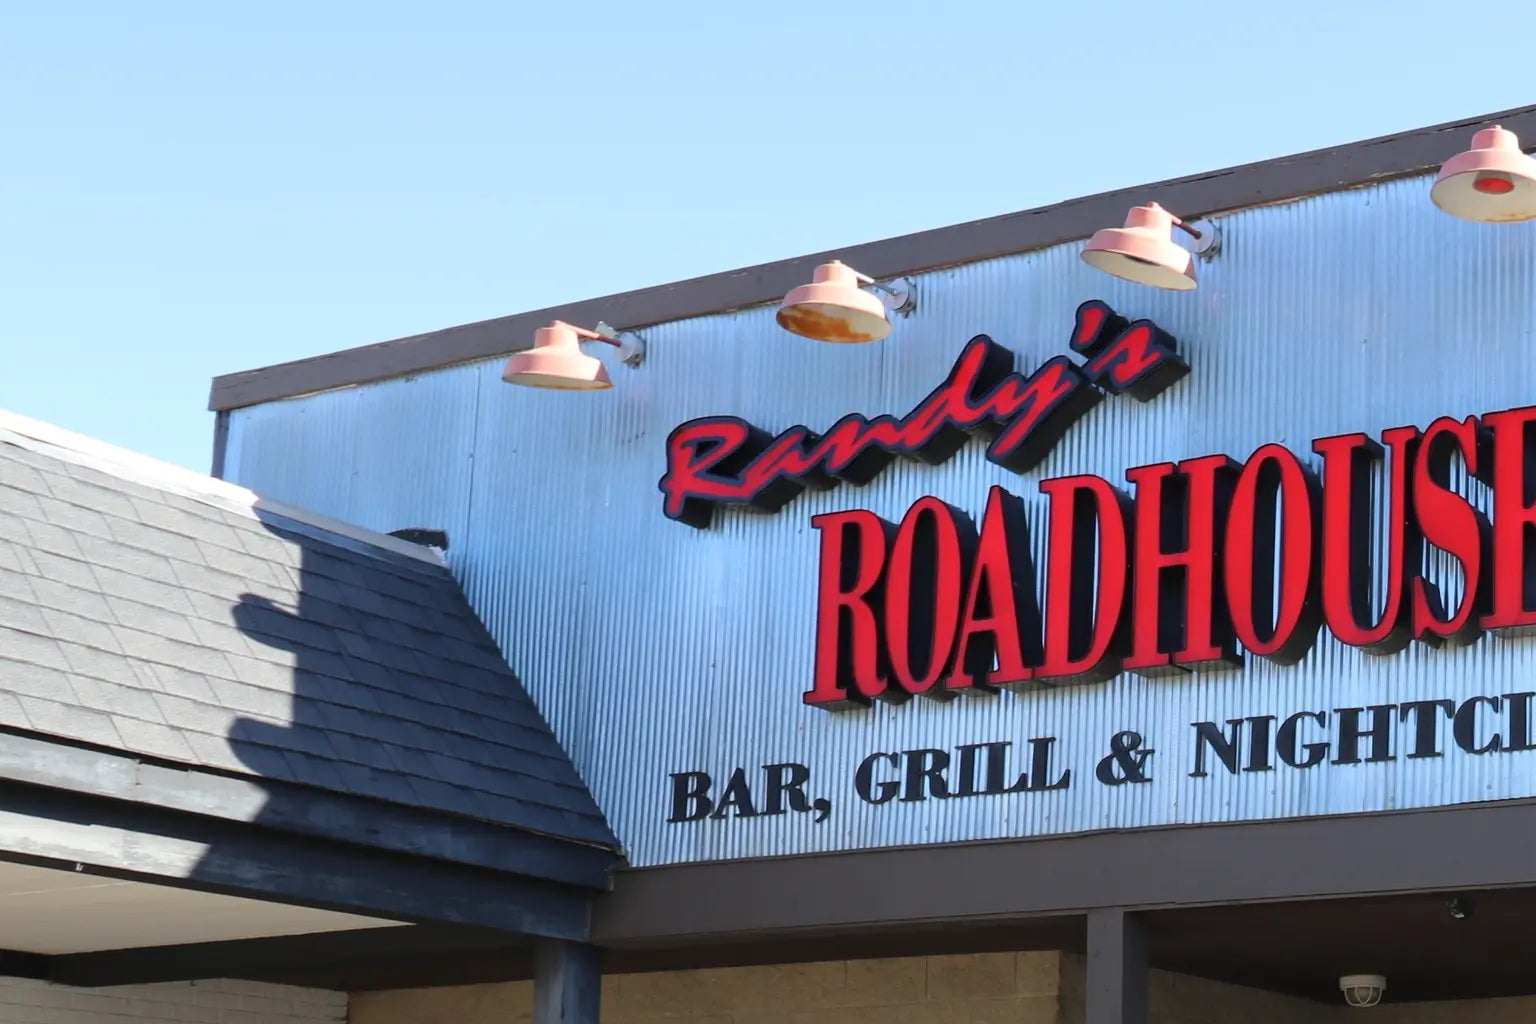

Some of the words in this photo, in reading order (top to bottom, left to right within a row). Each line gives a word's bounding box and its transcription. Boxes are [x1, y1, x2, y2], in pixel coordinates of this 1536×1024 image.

[659, 300, 1188, 525] Randy's
[666, 761, 832, 823] BAR,
[855, 736, 1072, 806] GRILL
[1096, 730, 1156, 787] &
